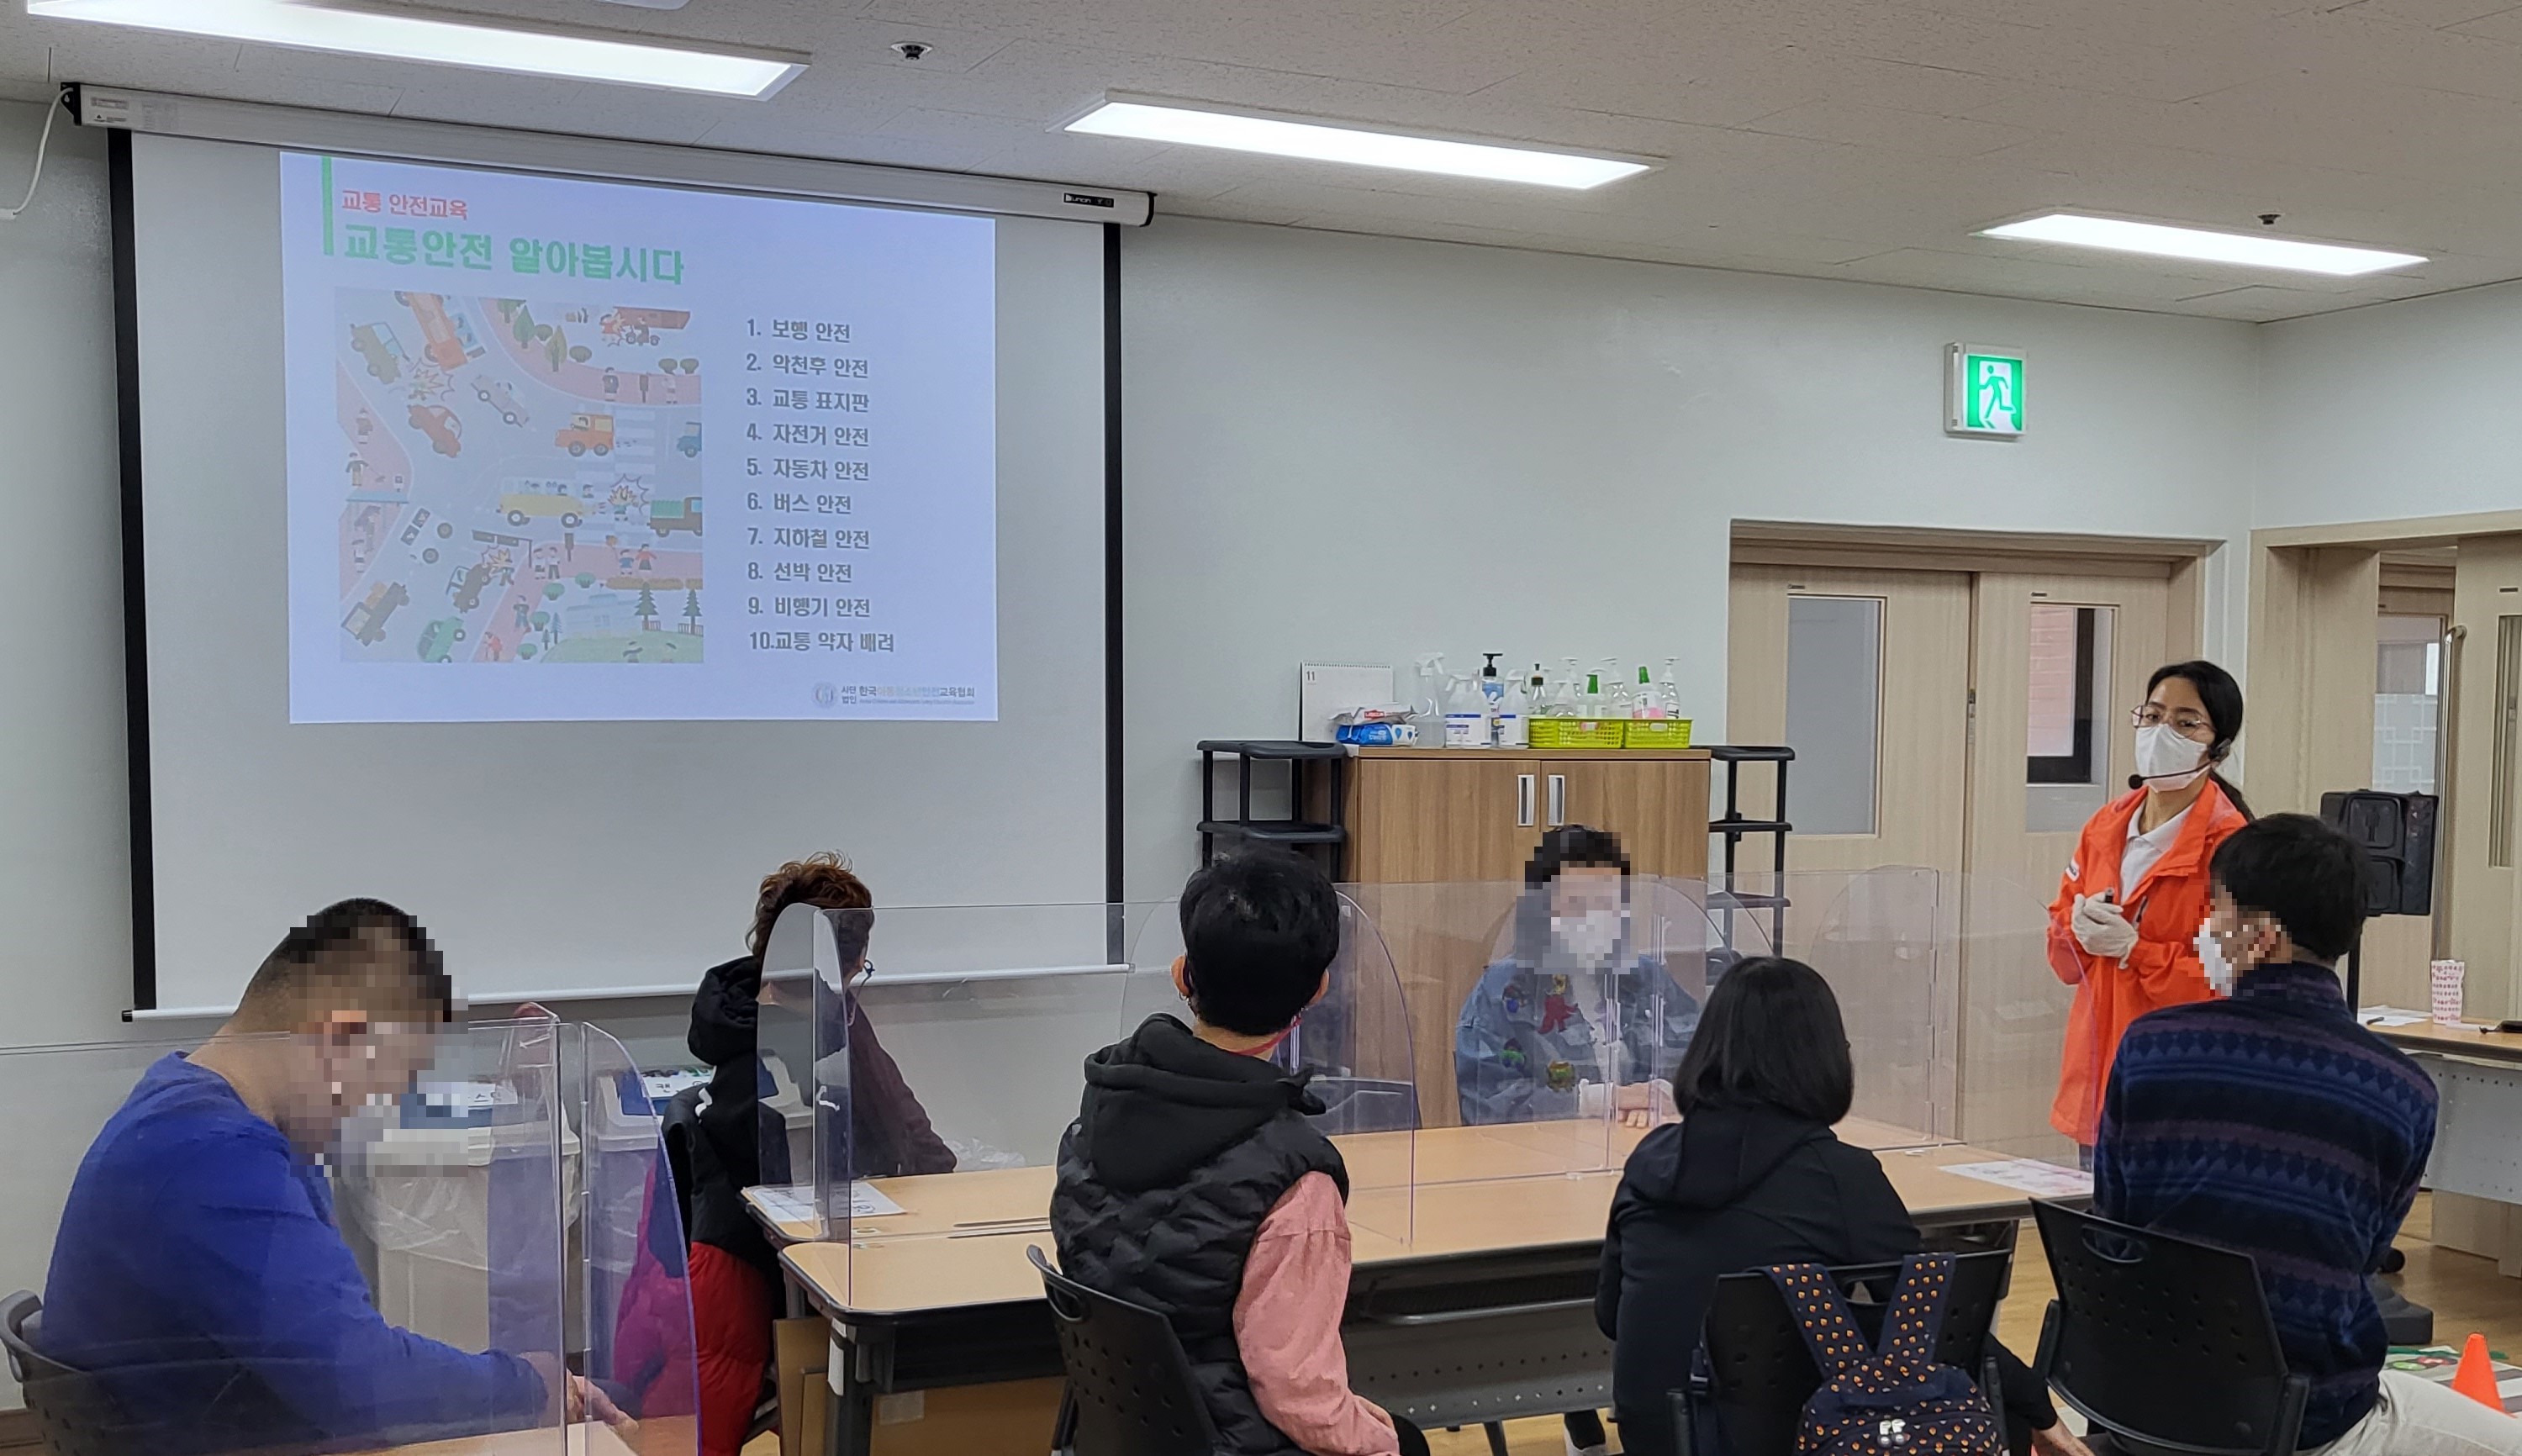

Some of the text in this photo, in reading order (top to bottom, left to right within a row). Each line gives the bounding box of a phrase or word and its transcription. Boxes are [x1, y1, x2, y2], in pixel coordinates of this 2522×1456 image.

[341, 188, 468, 220] 교통 안전교육
[344, 224, 685, 285] 교통안전 알아봅시다
[747, 319, 851, 343] 1. 보행 안전
[746, 353, 868, 379] 2. 악천후 안전
[746, 388, 869, 414] 3. 교통 표지판
[747, 423, 869, 447] 4. 자전거 안전
[747, 457, 869, 481] 5. 자동차 안전
[747, 492, 852, 514] 6. 버스 안전
[747, 527, 870, 550] 7. 지하철 안전
[747, 562, 852, 583] 8. 선박 안전
[747, 597, 871, 618] 9. 비행기 안전
[818, 632, 854, 652] 약자
[859, 632, 894, 653] 배려
[1306, 670, 1316, 682] 11
[842, 695, 857, 704] 법인
